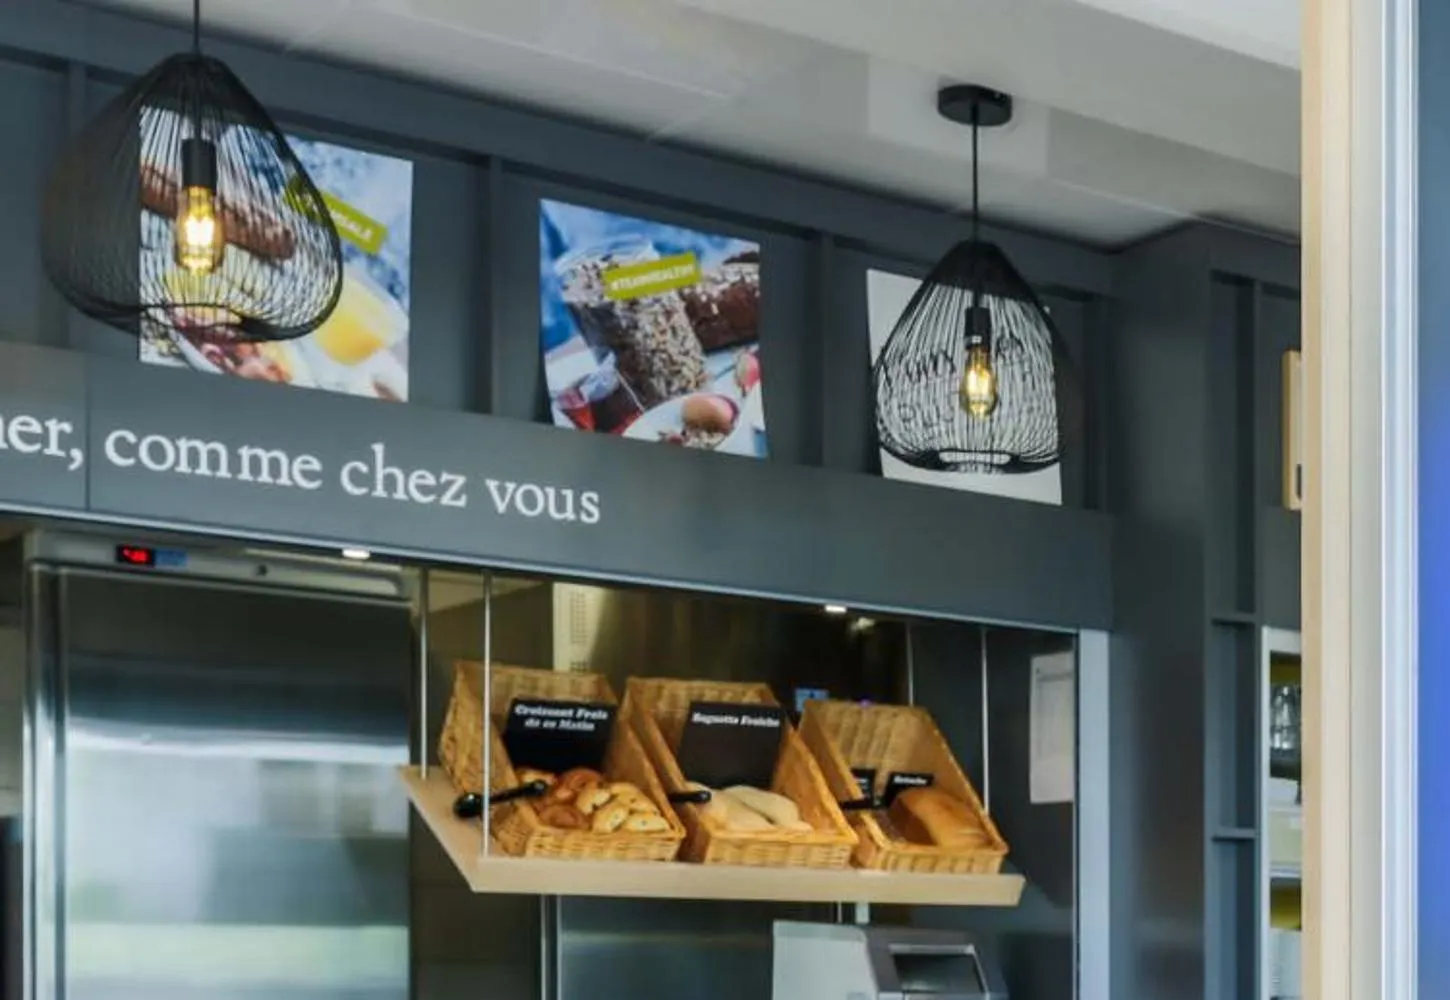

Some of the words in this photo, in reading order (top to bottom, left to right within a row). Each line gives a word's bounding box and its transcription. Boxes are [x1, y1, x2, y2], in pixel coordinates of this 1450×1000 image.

[0, 414, 83, 471] er,
[104, 429, 323, 490] comme
[340, 442, 467, 507] chez
[485, 478, 601, 524] vous
